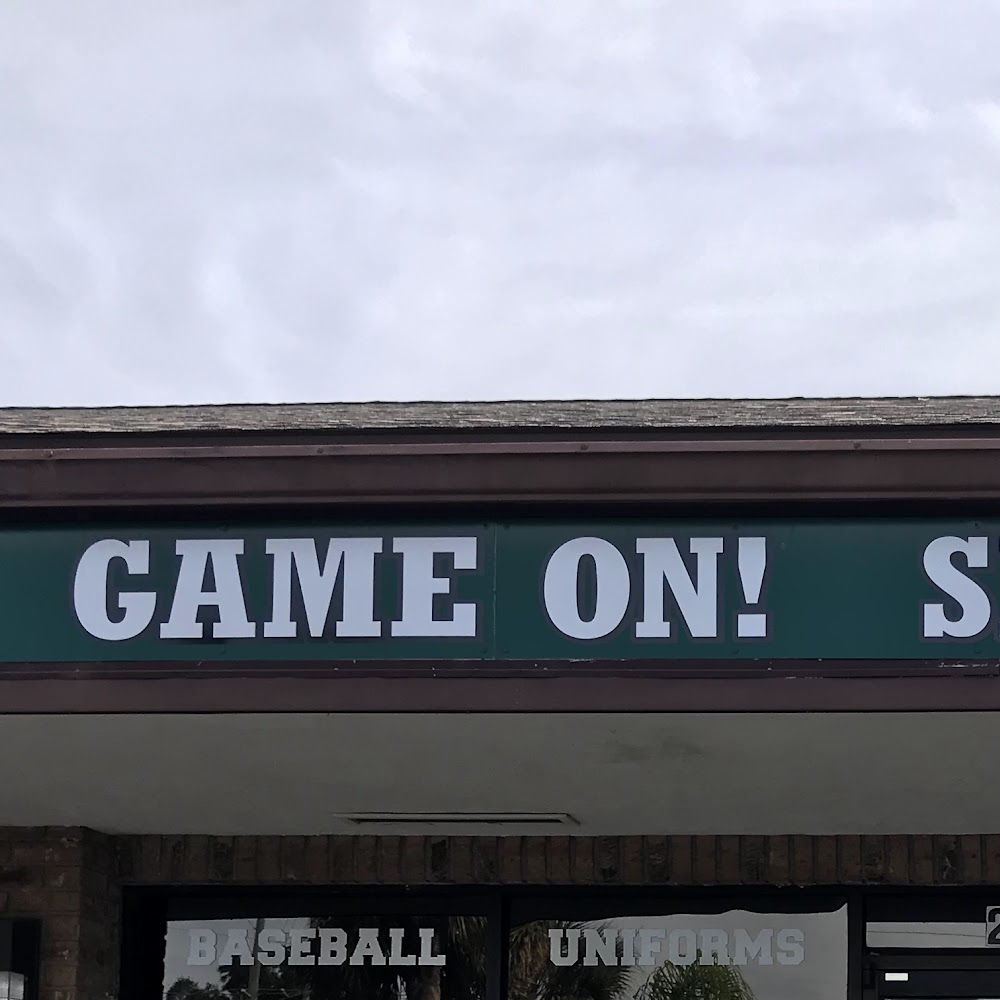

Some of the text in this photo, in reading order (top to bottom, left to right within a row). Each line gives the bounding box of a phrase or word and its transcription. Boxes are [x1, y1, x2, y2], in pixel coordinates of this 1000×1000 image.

[74, 536, 477, 641] GAME
[544, 536, 767, 640] ON!
[187, 928, 446, 966] BASEBALL
[548, 928, 805, 967] UNIFORMS
